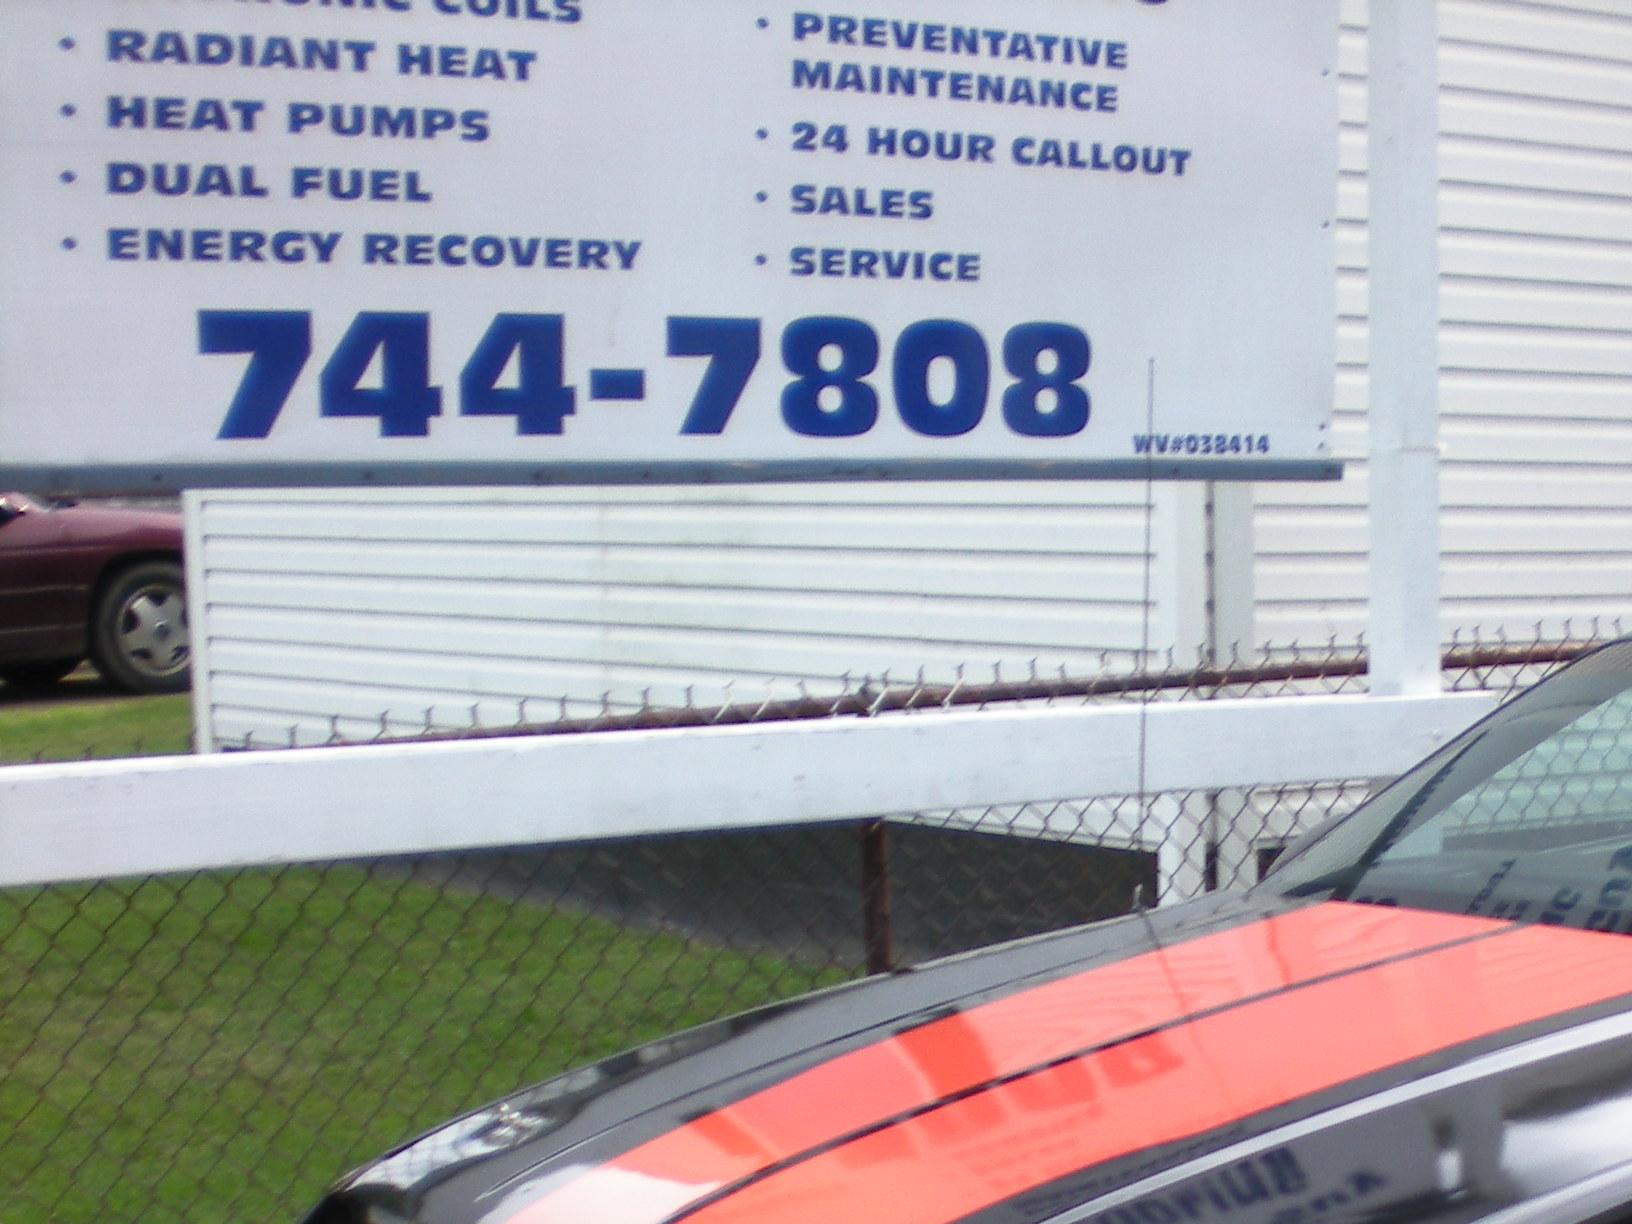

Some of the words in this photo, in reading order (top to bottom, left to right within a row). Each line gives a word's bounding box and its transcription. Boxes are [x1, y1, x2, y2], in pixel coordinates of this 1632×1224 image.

[106, 29, 376, 73] RADIANT
[397, 44, 537, 82] HEAT
[791, 12, 1128, 70] PREVENTATIVE
[790, 59, 1119, 113] MAINTENANCE
[106, 95, 265, 133] HEAT
[287, 102, 490, 142] PUMPS
[791, 121, 849, 153] 24
[867, 127, 996, 163] HOUR
[1011, 137, 1192, 177] CALLOUT
[106, 161, 269, 198] DUAL
[290, 166, 433, 203] FUEL
[790, 184, 934, 220] SALES
[106, 228, 343, 264] ENERGY
[363, 232, 642, 270] RECOVERY
[789, 246, 981, 282] SERVICE
[197, 309, 1092, 441] 744-7808
